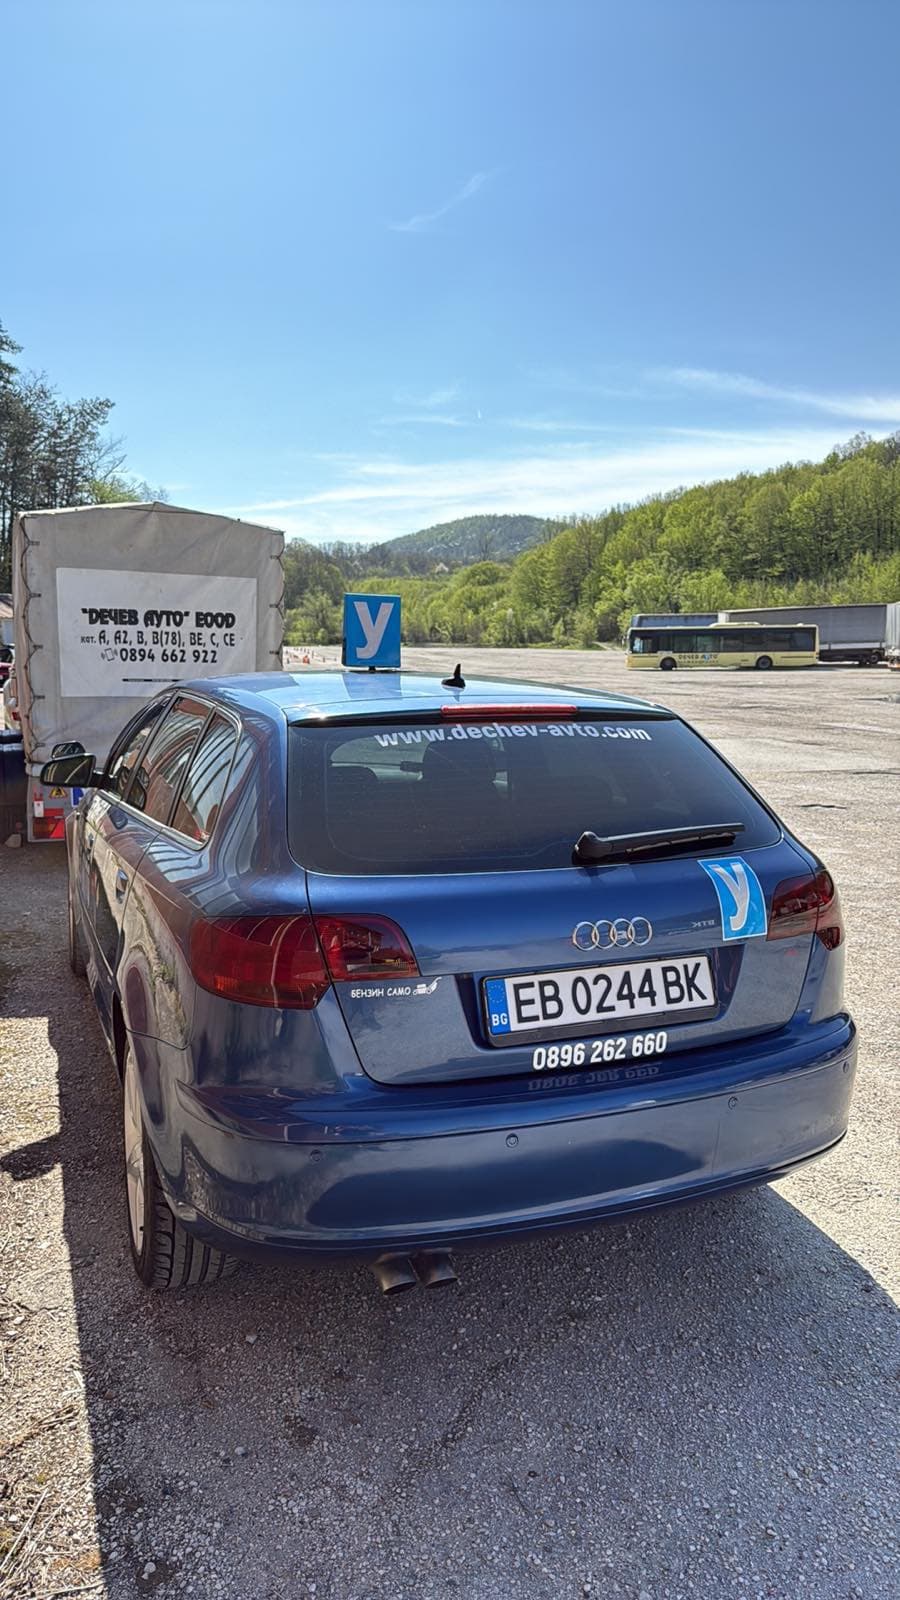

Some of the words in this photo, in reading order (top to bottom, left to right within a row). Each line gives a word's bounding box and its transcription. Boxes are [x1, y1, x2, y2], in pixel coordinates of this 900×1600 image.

[152, 630, 185, 648] B(78),
[119, 647, 156, 663] 0894
[161, 648, 187, 663] 662
[192, 649, 218, 664] 922
[374, 722, 652, 748] www.dechev-avto.com
[350, 988, 385, 999] БЕНЗИН
[386, 986, 412, 997] САМО
[571, 968, 657, 1016] 0244
[491, 1013, 508, 1027] BG
[532, 1043, 586, 1071] 0896
[590, 1037, 627, 1064] 262
[631, 1031, 668, 1057] 660
